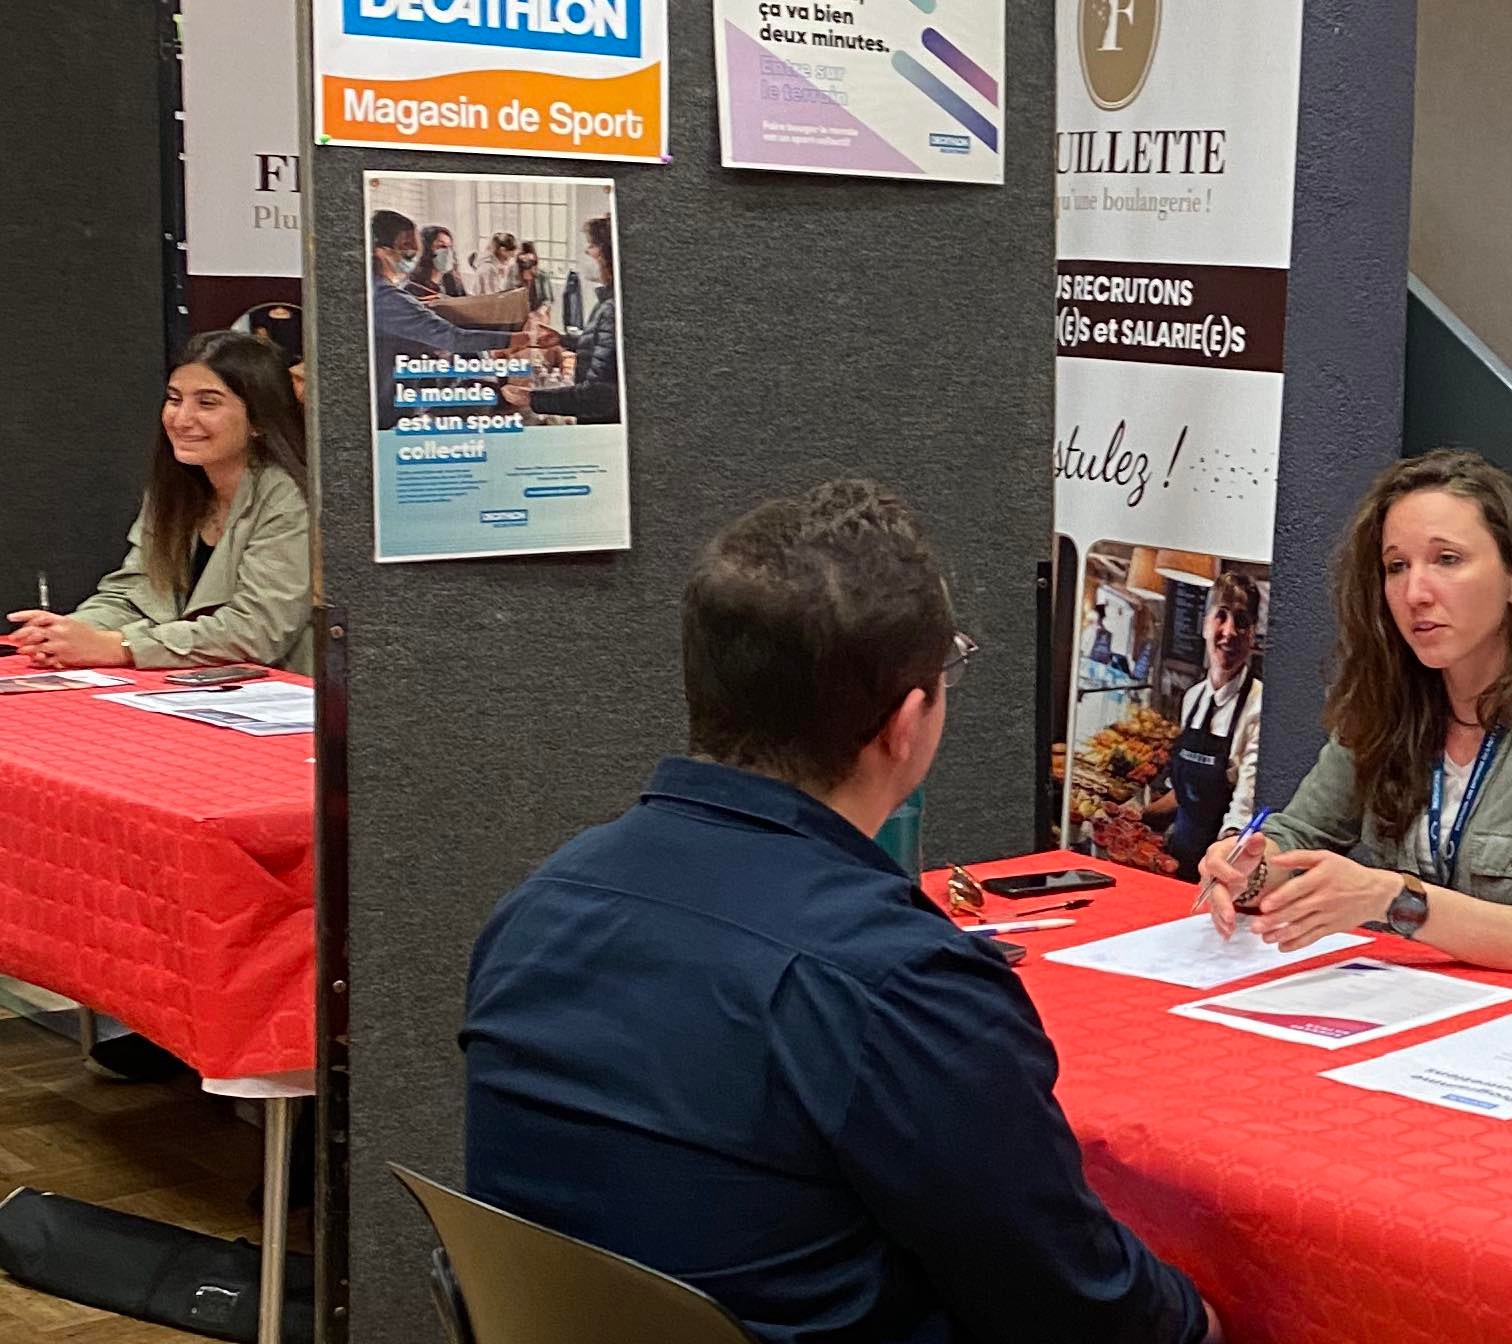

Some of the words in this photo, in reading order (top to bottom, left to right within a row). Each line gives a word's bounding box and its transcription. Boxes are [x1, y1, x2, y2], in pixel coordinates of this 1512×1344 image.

[759, 2, 781, 21] ça
[786, 4, 810, 21] va
[814, 4, 855, 25] bien
[759, 24, 807, 45] deux
[811, 31, 890, 53] minutes.
[344, 88, 489, 136] Magasin
[499, 99, 540, 132] de
[549, 102, 643, 145] Sport
[1103, 187, 1201, 221] boulangerie
[1074, 276, 1194, 307] RECRUTONS
[1093, 319, 1118, 344] et
[1121, 314, 1247, 358] SALARIE(E)S
[394, 354, 450, 374] Faire
[453, 354, 530, 377] bouger
[395, 383, 417, 403] le
[420, 383, 496, 402] monde
[397, 415, 431, 431] est
[435, 415, 464, 430] un
[467, 413, 524, 433] sport
[398, 440, 486, 461] collectif
